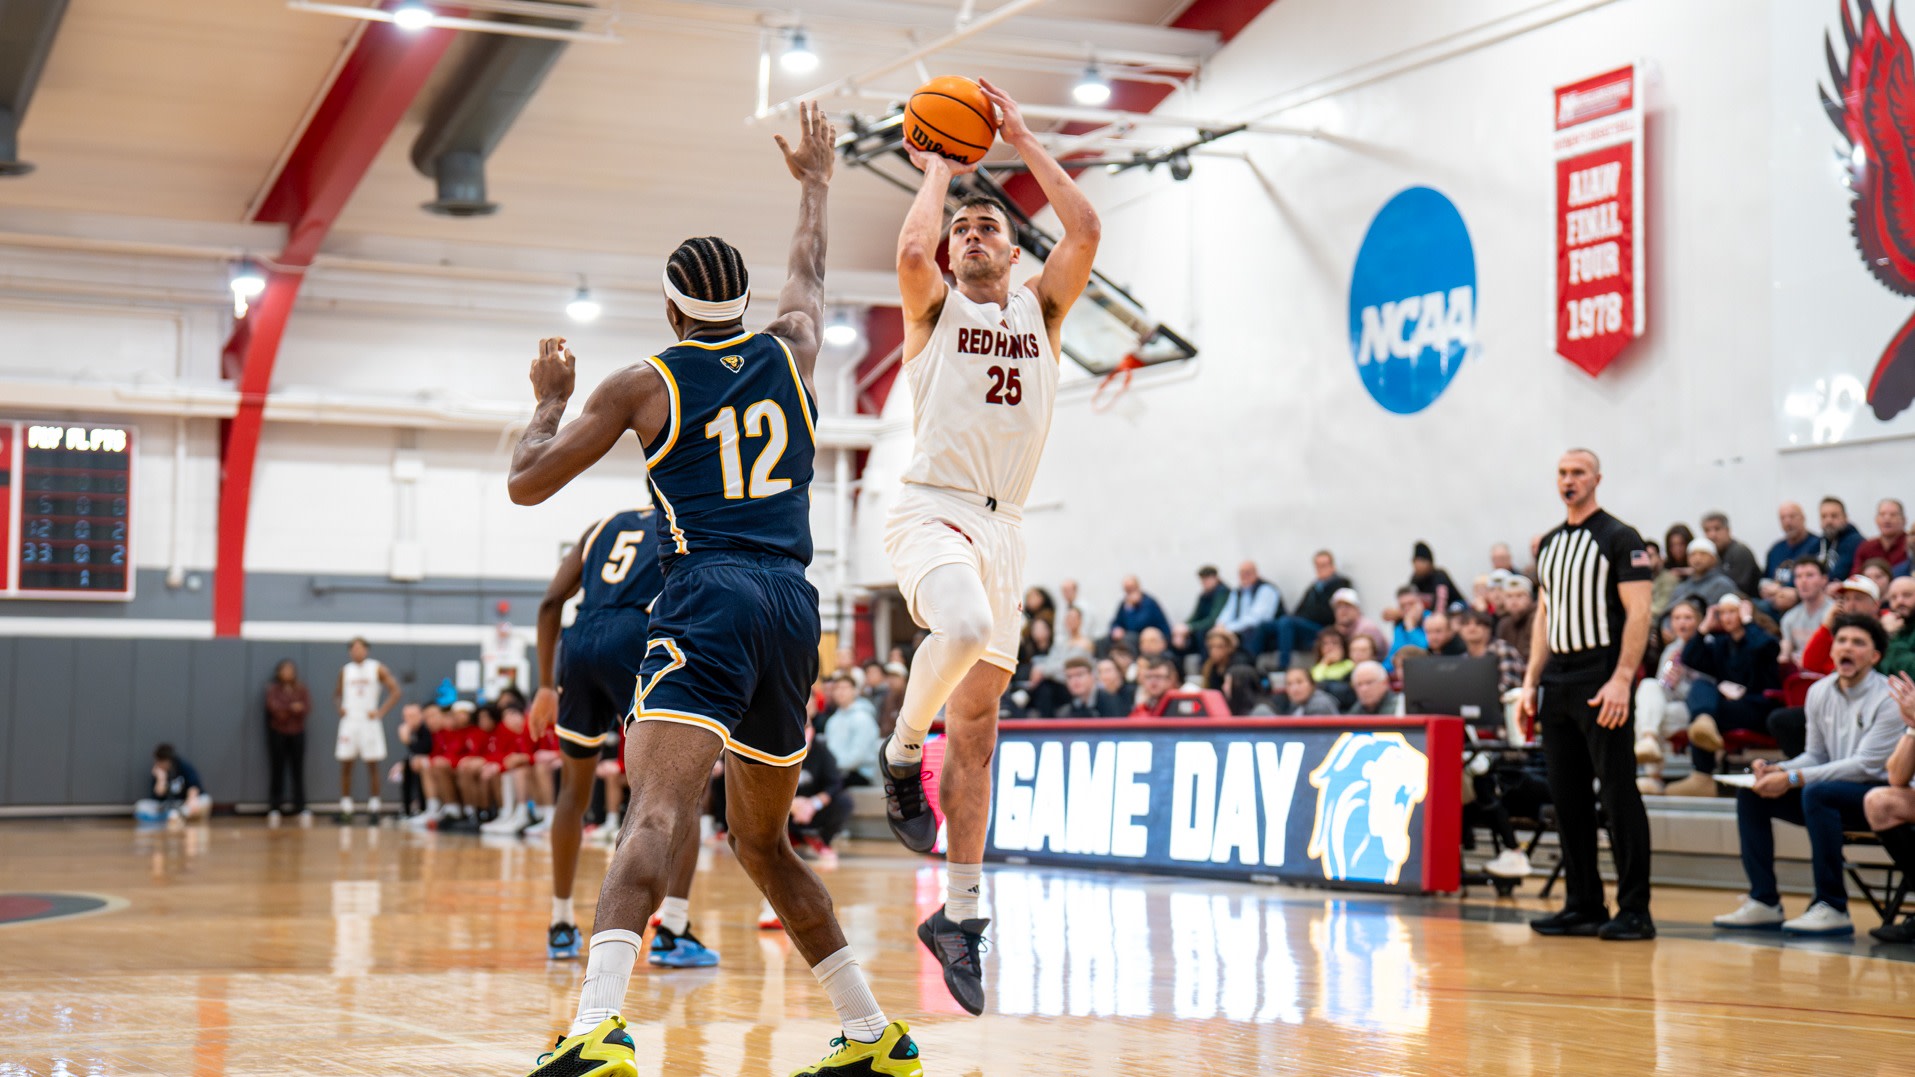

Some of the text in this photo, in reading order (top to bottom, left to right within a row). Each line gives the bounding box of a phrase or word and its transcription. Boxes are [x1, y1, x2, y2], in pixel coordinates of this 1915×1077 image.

[1566, 201, 1623, 247] FINAL
[1568, 241, 1620, 285] FOUR
[1358, 285, 1473, 366] NCAA
[1566, 291, 1623, 340] 1978
[985, 365, 1022, 406] 25
[705, 398, 793, 500] 12
[23, 542, 52, 564] 33
[111, 544, 126, 565] 2
[601, 530, 645, 585] 5
[994, 740, 1305, 867] GAME DAY
